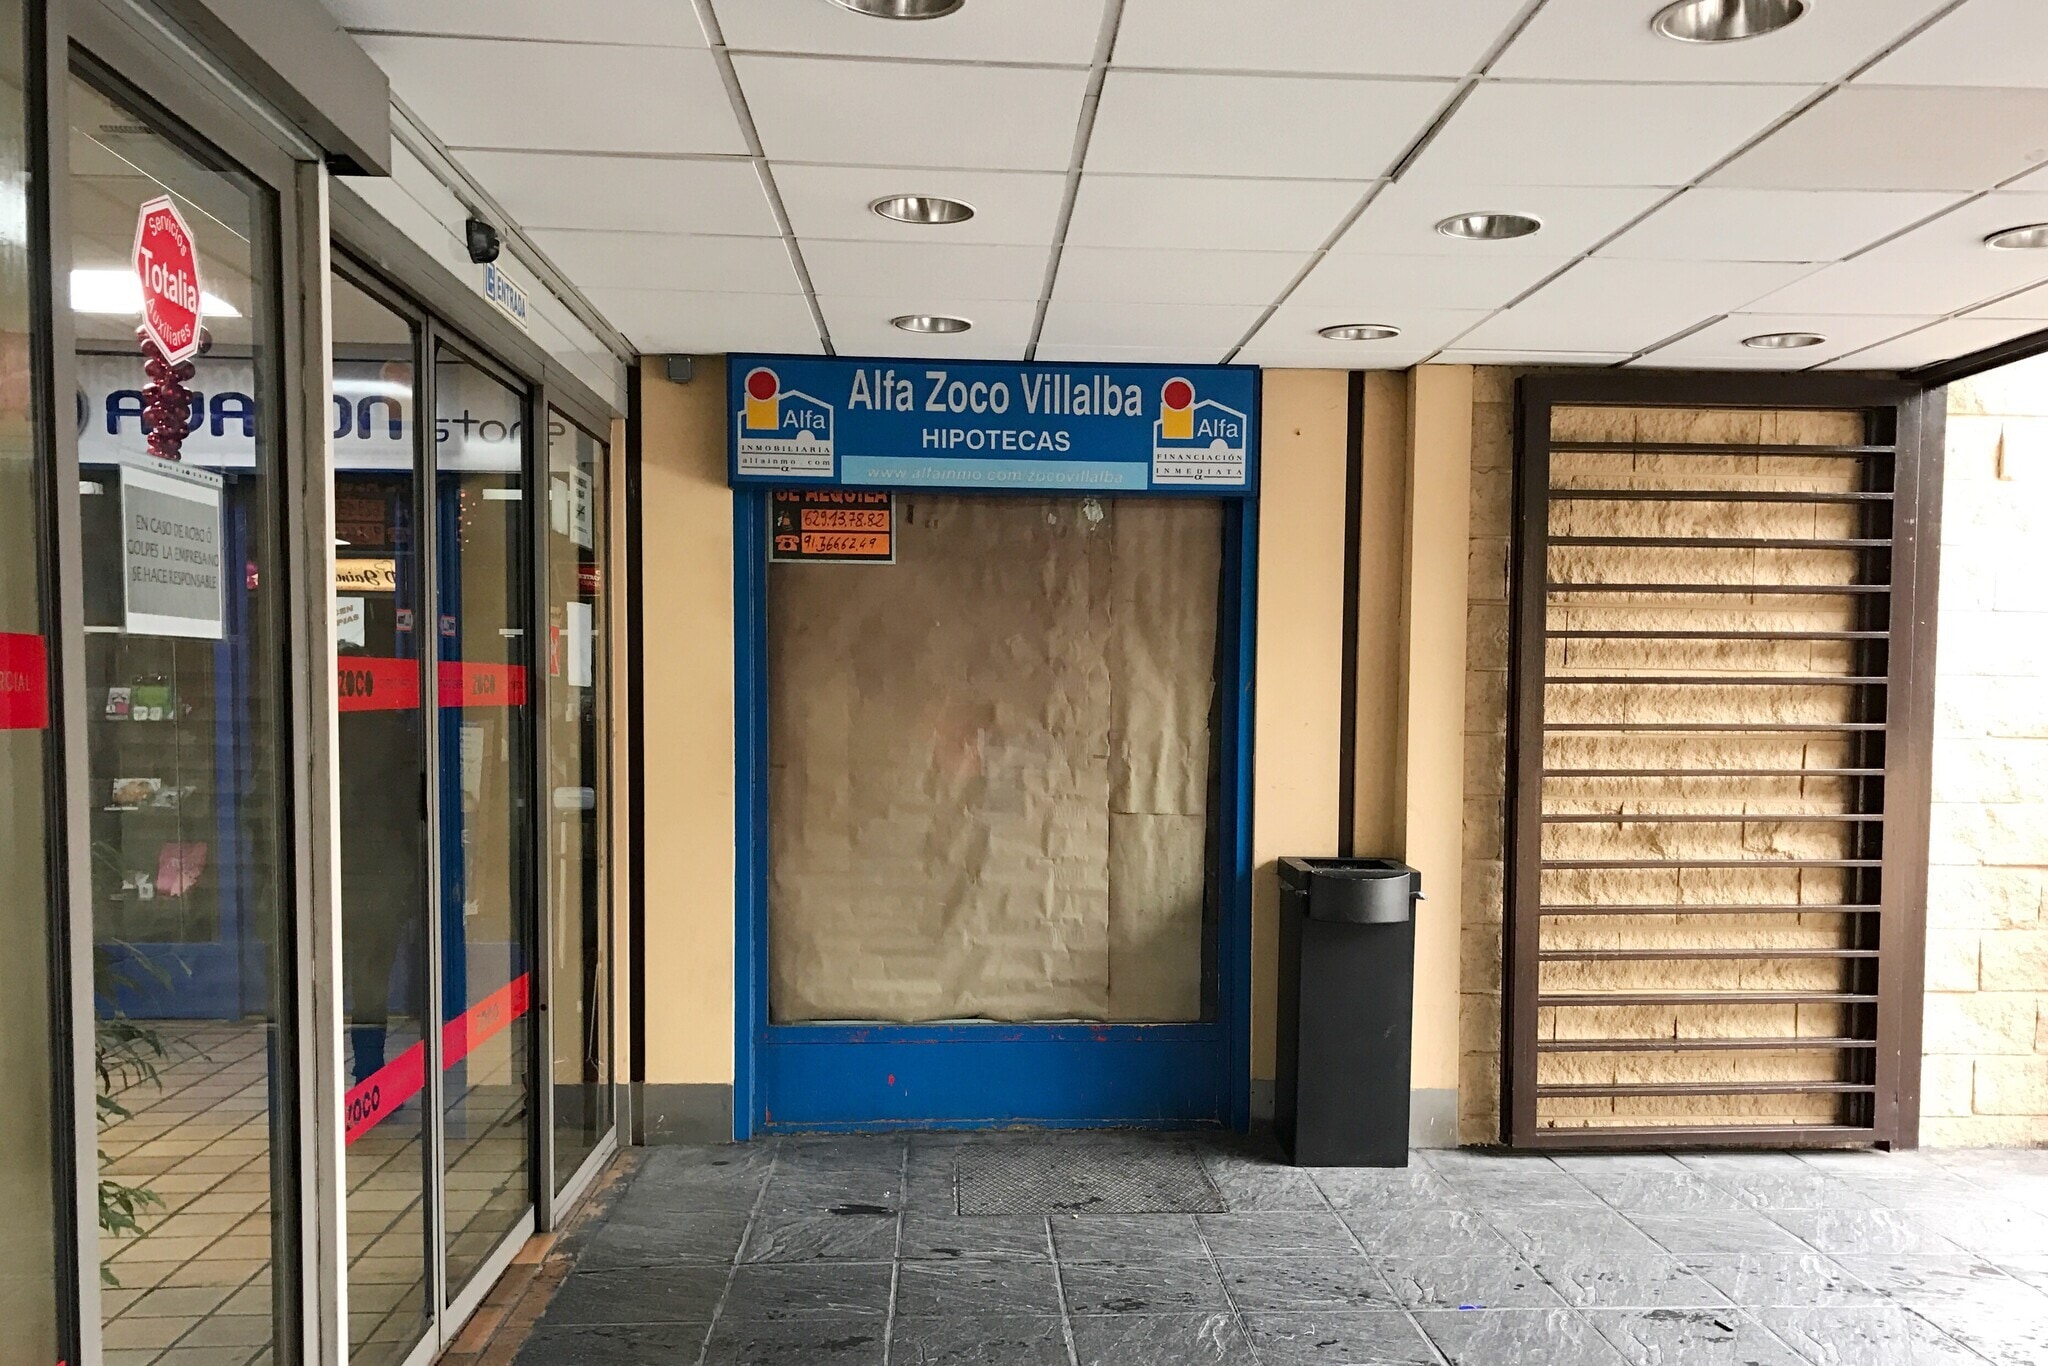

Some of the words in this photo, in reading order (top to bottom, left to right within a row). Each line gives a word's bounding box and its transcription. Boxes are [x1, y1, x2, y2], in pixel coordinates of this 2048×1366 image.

[149, 215, 187, 257] Servicios
[140, 246, 198, 315] Totalia
[498, 275, 526, 319] ENTRADA
[147, 297, 192, 347] Auxiliares
[848, 368, 914, 412] Alfa
[925, 370, 1010, 414] Zoco
[1020, 373, 1143, 417] Villalba
[782, 409, 826, 429] Alfa
[1197, 418, 1239, 438] Alfa
[741, 444, 831, 453] INMOBILIARIA
[922, 428, 1071, 452] HIPOTECAS
[1156, 452, 1243, 462] FINANCIACIÓN
[1156, 467, 1243, 476] INMEDIATA
[136, 514, 149, 531] EN
[151, 517, 172, 537] CASO
[173, 523, 184, 539] DE
[184, 525, 205, 542] ROBO
[126, 539, 159, 559] GOLPES
[162, 544, 173, 561] LA
[175, 547, 207, 565] EMPRESA
[208, 553, 219, 567] NO
[143, 567, 168, 584] HACE
[169, 571, 217, 589] RESPONSABLE
